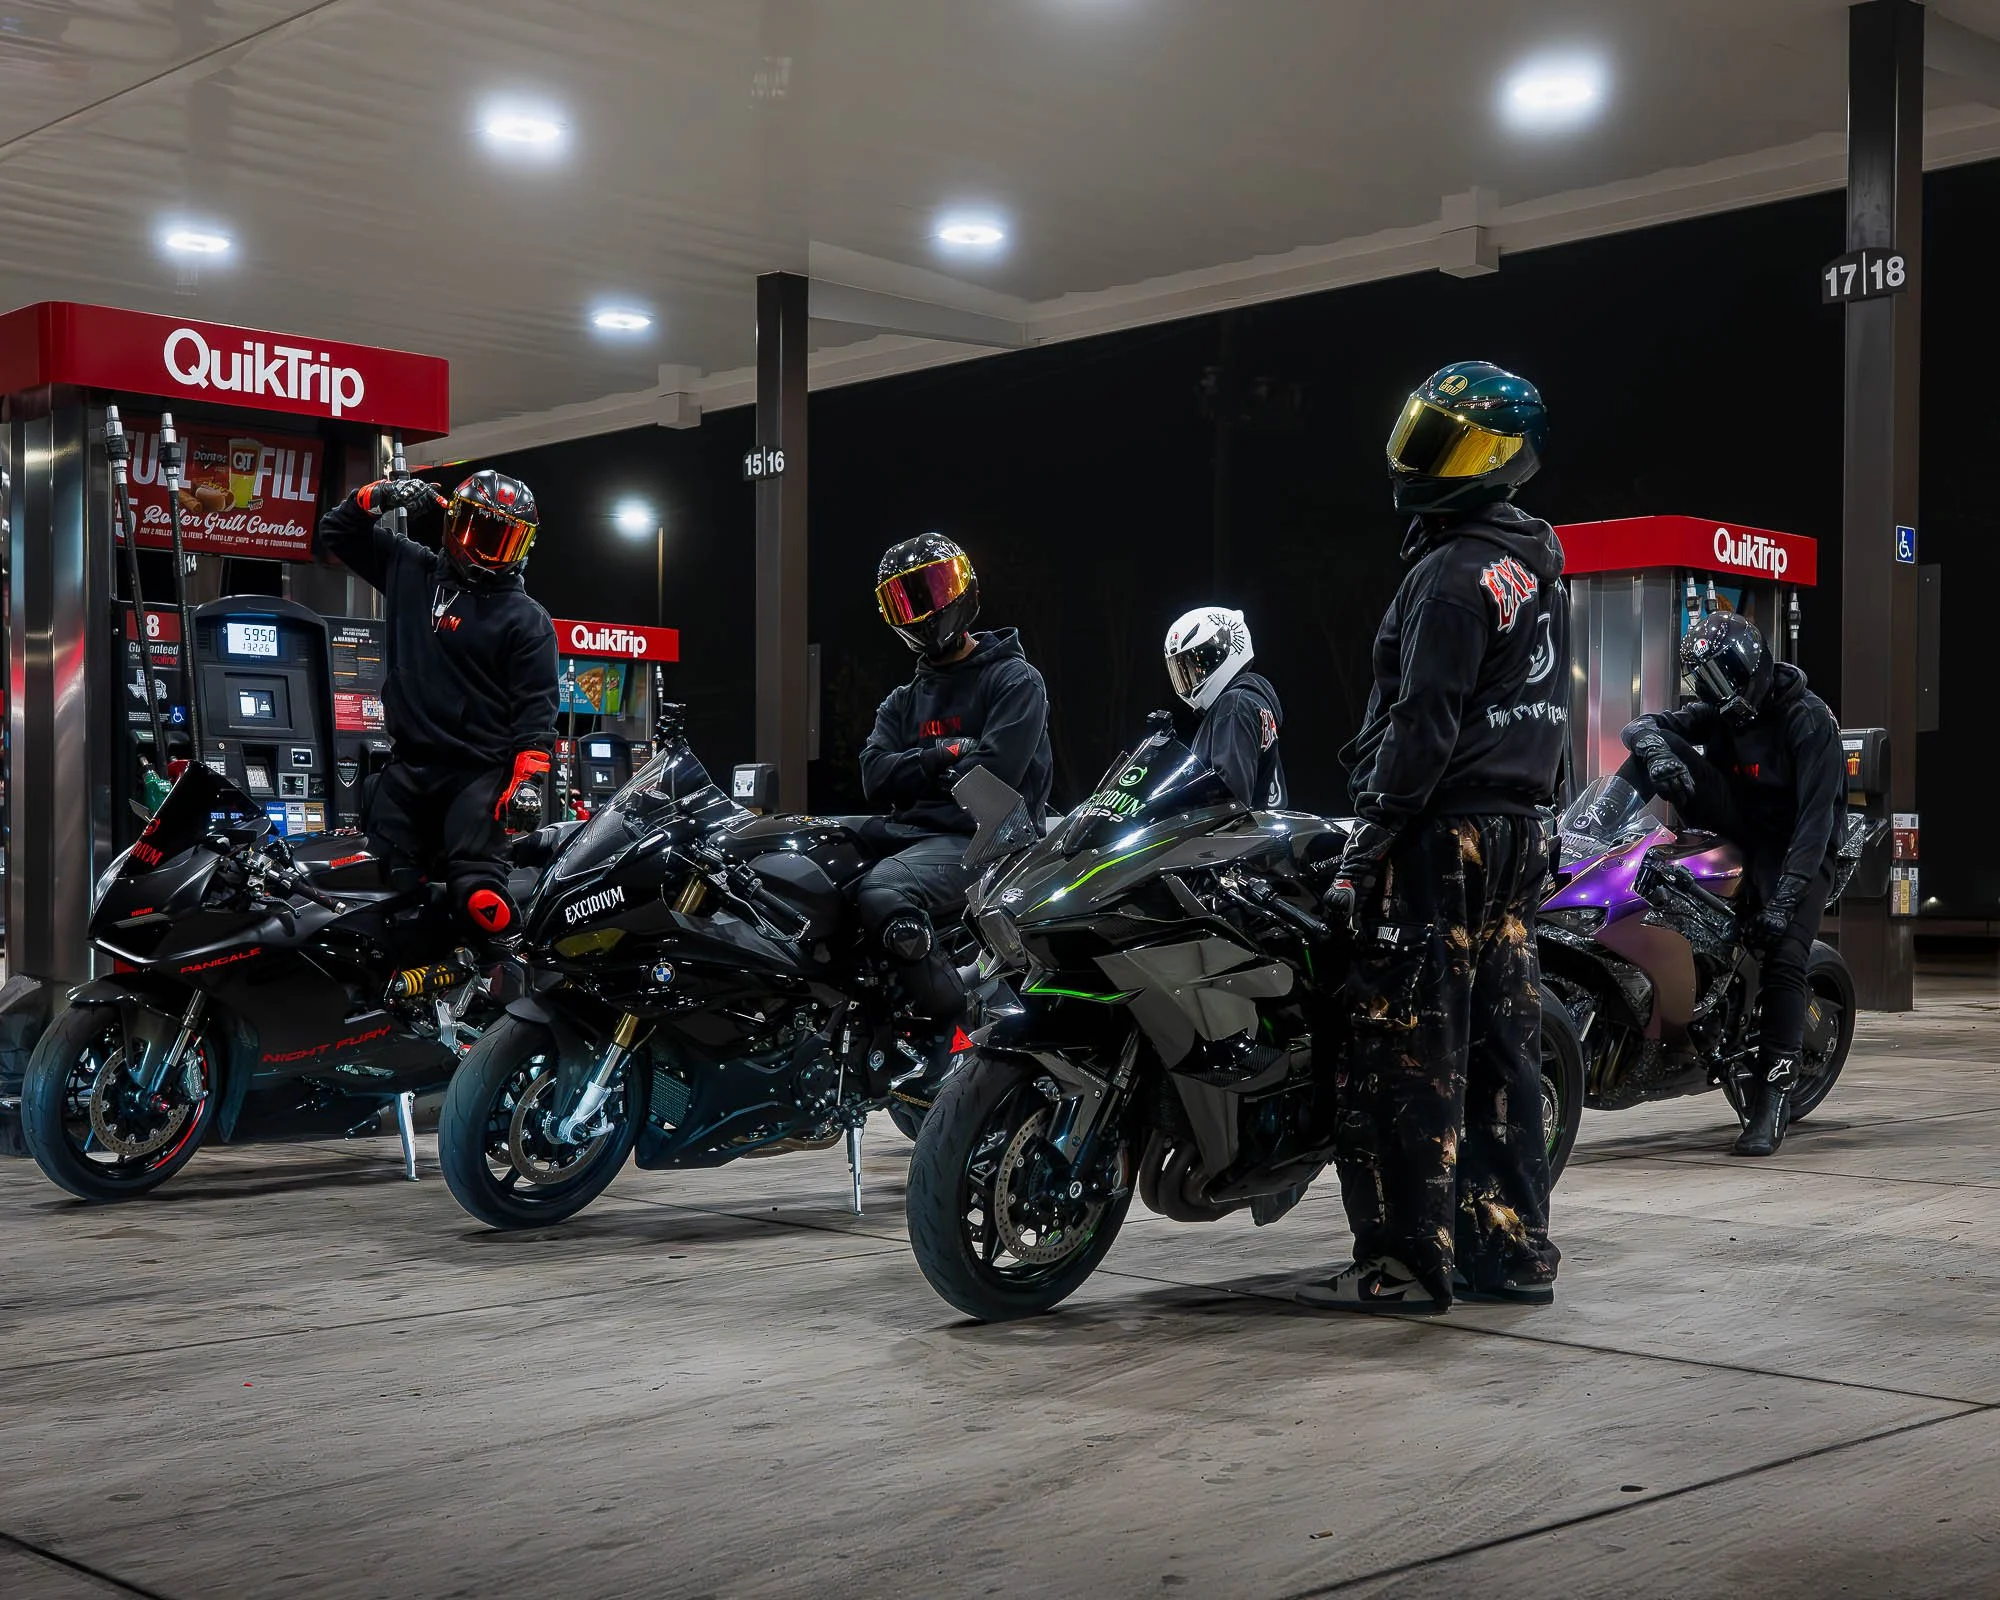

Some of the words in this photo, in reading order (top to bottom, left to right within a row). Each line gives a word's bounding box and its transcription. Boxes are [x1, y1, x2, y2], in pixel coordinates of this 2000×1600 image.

[1825, 264, 1857, 297] 17
[1869, 256, 1905, 290] 18
[164, 328, 365, 417] QuikTrip
[123, 430, 192, 489] UL
[253, 446, 316, 502] FILL
[233, 452, 254, 471] QT
[745, 453, 763, 476] 15
[767, 450, 785, 473] 16
[142, 505, 202, 528] Roler
[204, 512, 247, 534] Grill
[247, 515, 307, 537] Combo
[1713, 527, 1788, 580] QuikTrip
[146, 614, 160, 637] 8
[571, 624, 648, 658] QuikTrip
[128, 641, 179, 656] Guanteed
[564, 885, 625, 925] EXCIDIVM
[180, 947, 262, 974] PANIGALE
[263, 1043, 332, 1062] NIGHT
[335, 1024, 391, 1051] FURY
